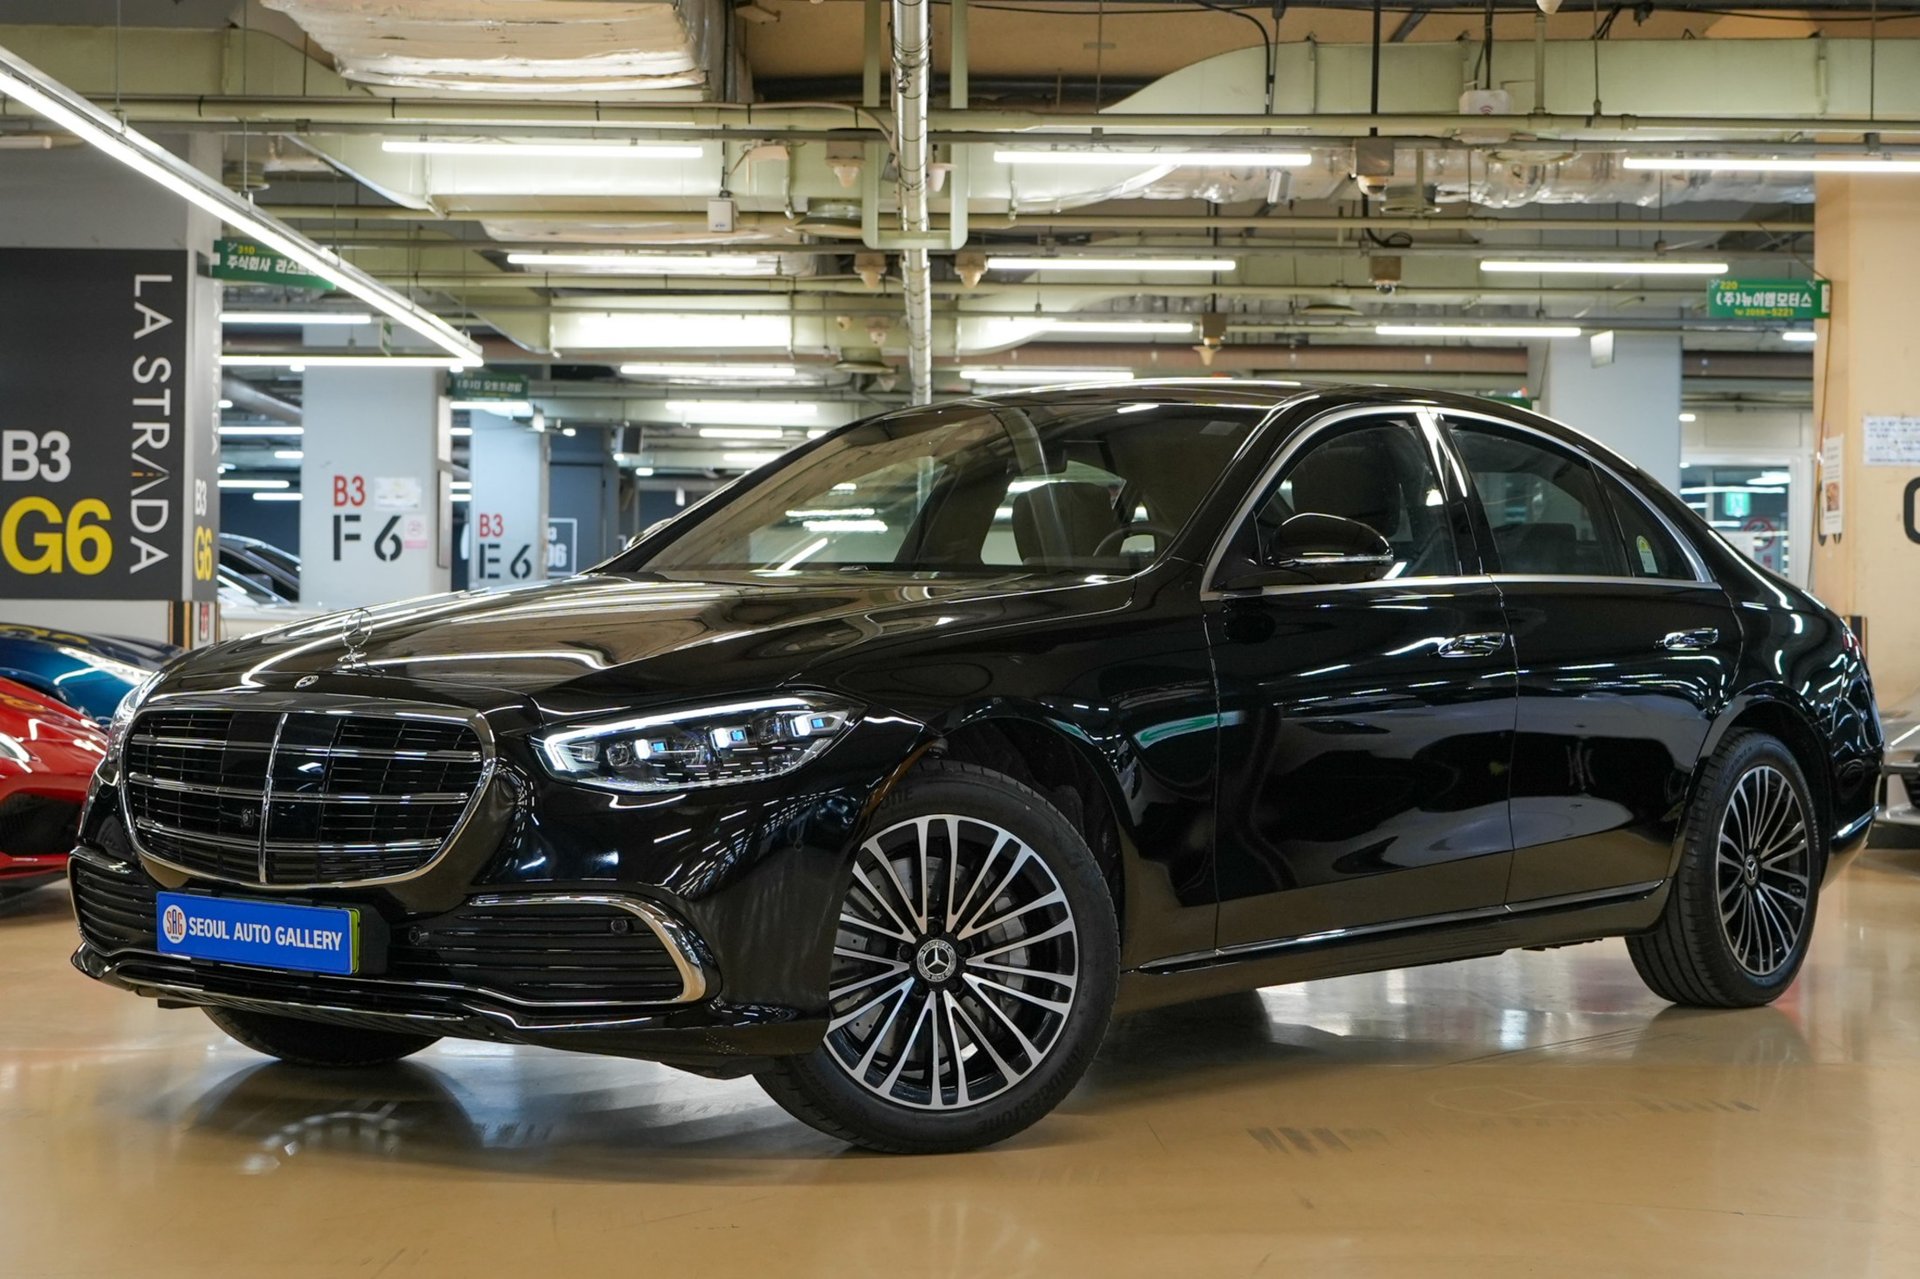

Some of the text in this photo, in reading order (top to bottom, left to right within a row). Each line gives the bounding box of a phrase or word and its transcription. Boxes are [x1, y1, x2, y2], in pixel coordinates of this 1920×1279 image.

[226, 254, 272, 272] 주식회사
[129, 274, 173, 574] LA STRADA
[2, 430, 71, 482] B3
[195, 479, 207, 516] B3
[334, 475, 365, 507] B3
[1, 496, 112, 575] G6
[480, 514, 503, 537] B3
[194, 526, 213, 580] G6
[166, 908, 183, 936] SAG
[189, 916, 342, 951] SEOUL AUTO GALLERY
